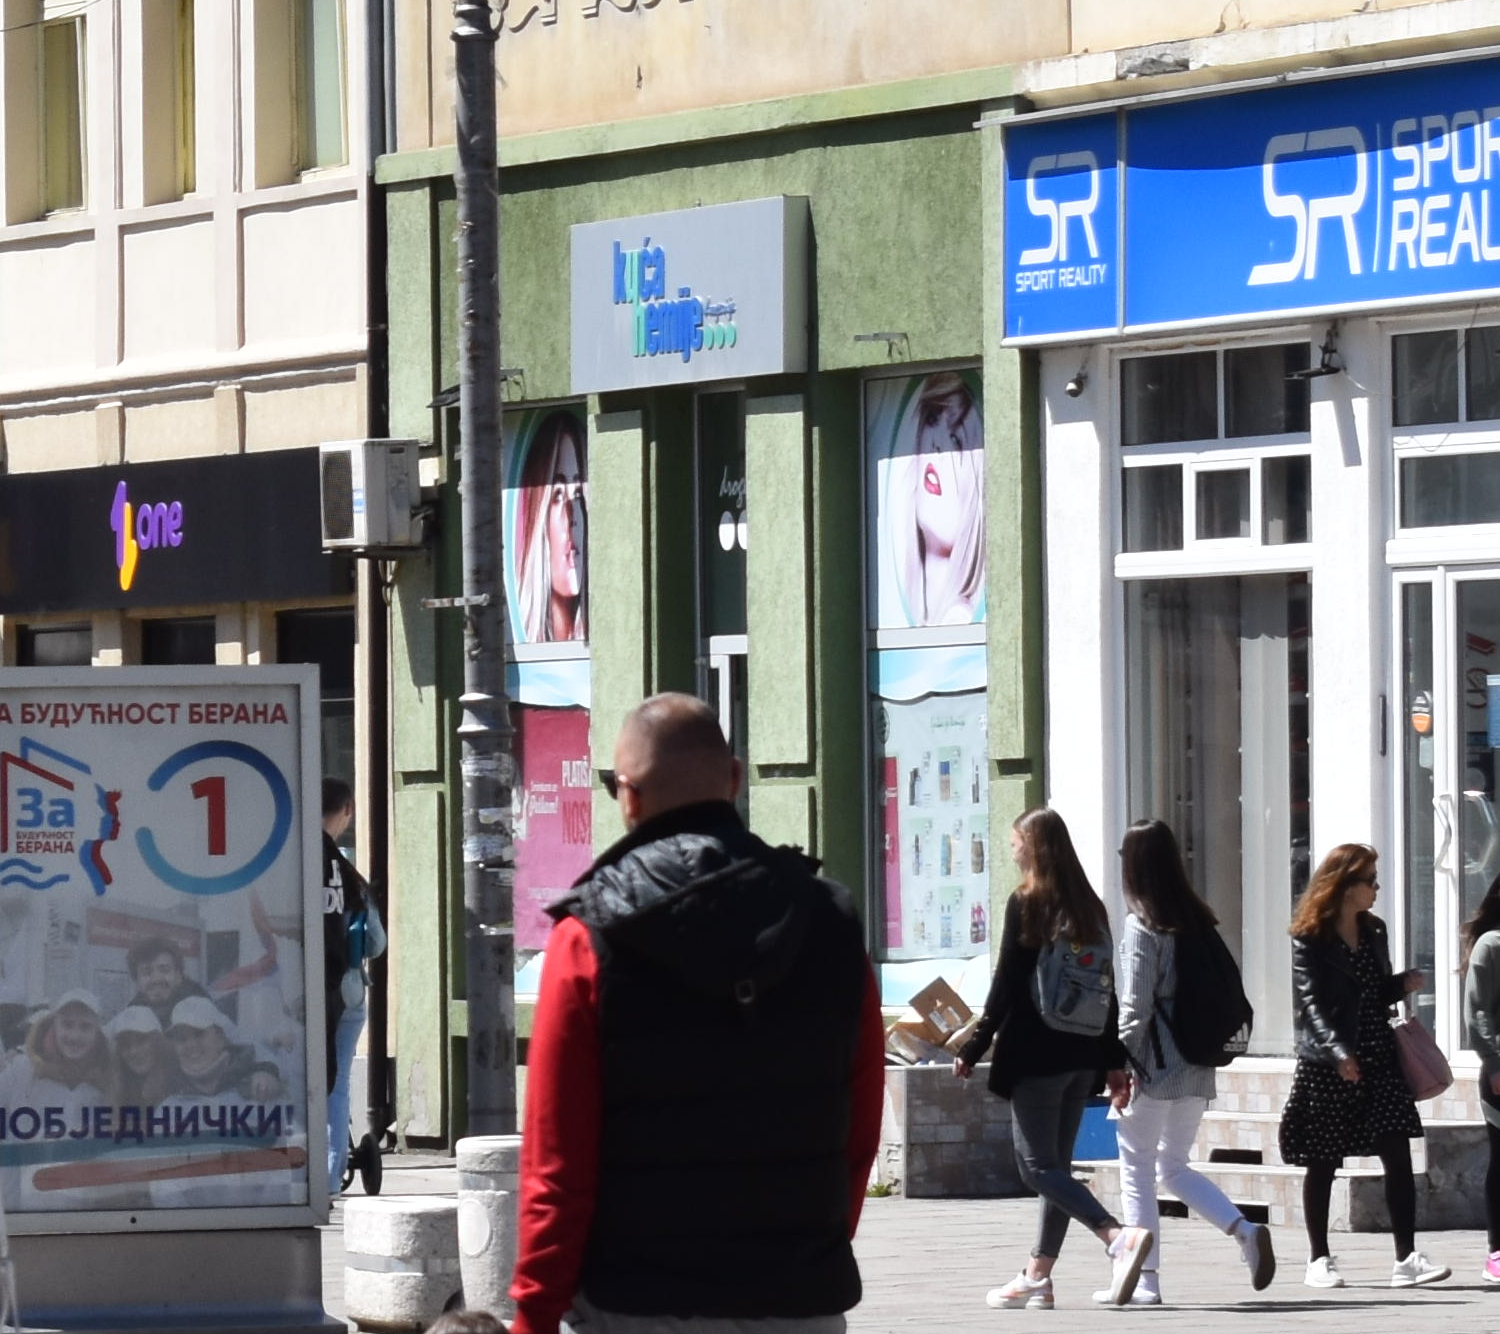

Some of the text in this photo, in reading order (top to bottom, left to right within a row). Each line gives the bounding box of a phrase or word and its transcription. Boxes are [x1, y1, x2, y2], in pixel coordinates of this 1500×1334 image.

[1015, 264, 1107, 293] SPORT REALITY
[136, 500, 203, 551] one
[20, 703, 180, 728] БУДУЋНОСТ
[188, 703, 288, 725] БЕРАНА
[16, 788, 75, 828] За
[191, 776, 227, 856] 1
[16, 831, 75, 841] БУДУЋНОСТ
[16, 841, 75, 854] БЕРАНА
